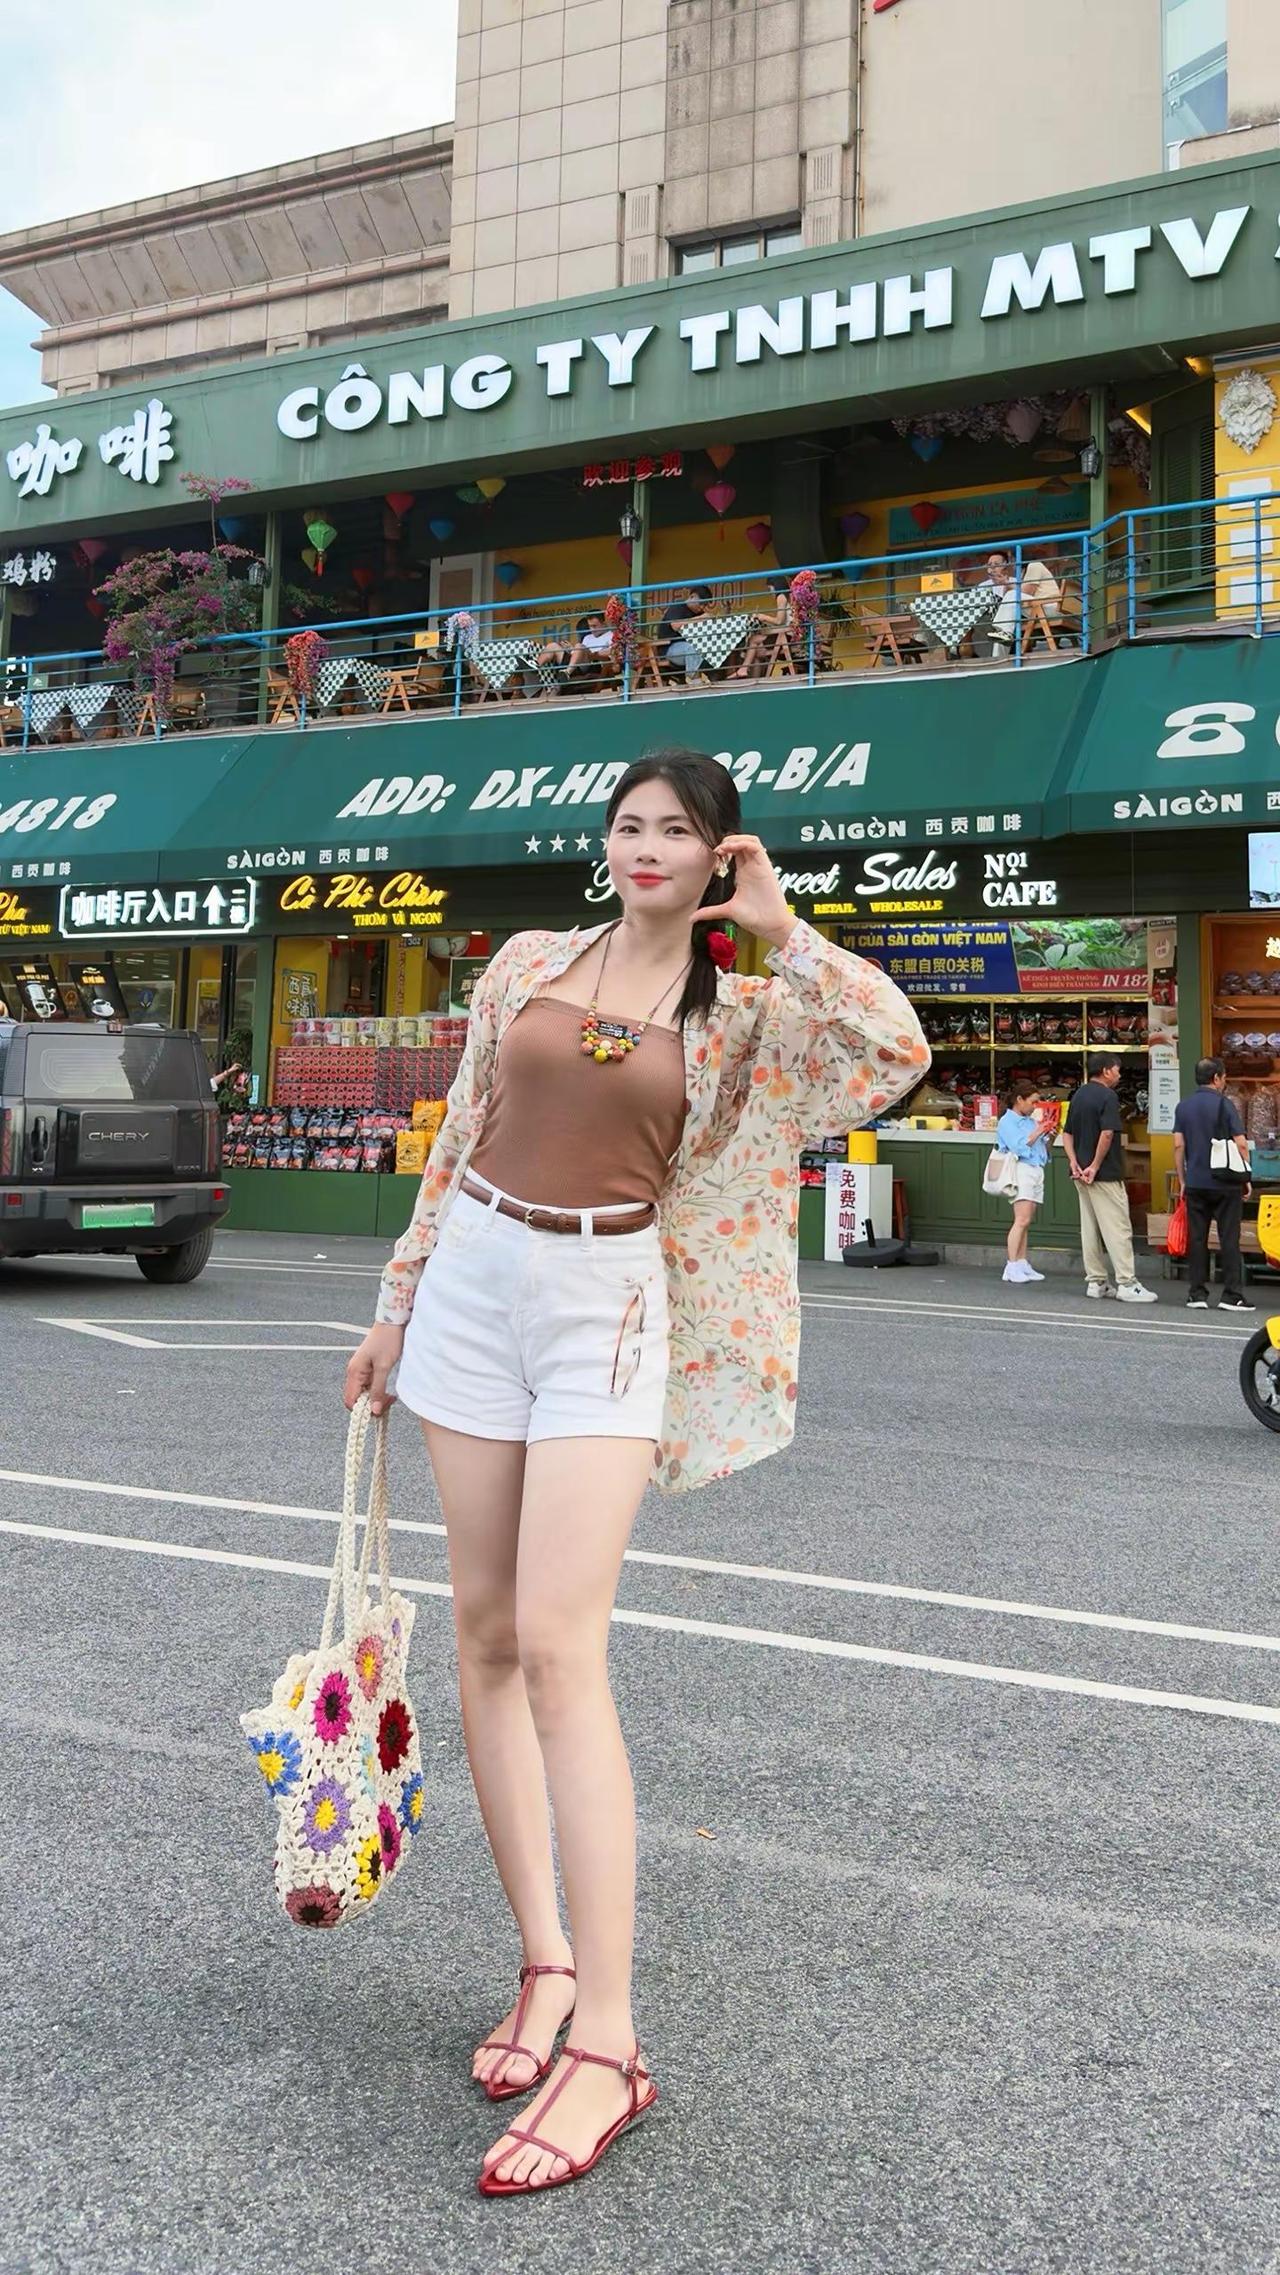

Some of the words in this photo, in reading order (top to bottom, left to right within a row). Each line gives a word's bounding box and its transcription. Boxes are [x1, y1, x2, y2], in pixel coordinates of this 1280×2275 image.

[277, 362, 513, 441] CÔNG
[536, 325, 659, 398] TY
[679, 266, 956, 373] TNHH
[979, 205, 1253, 321] MTV
[336, 773, 457, 819] ADD:
[1113, 789, 1243, 819] SÀIGÒN
[0, 793, 118, 834] 4818
[800, 816, 907, 842] SÀIGÒN
[925, 813, 1023, 836] 西贡咖啡
[319, 846, 389, 865] 西贡咖啡
[773, 863, 841, 895] irect
[854, 850, 958, 896] Sales
[323, 874, 375, 909] Phê
[983, 880, 1058, 908] CAFE
[71, 889, 197, 927] 咖啡厅入口
[392, 910, 406, 927] VÀ
[409, 912, 443, 926] NGON
[870, 900, 944, 913] WHOLESALE
[887, 931, 909, 946] SÀI
[911, 931, 940, 946] GÒN
[943, 930, 973, 948] VIỆT
[975, 932, 1007, 946] NAM
[889, 957, 985, 974] 东盟自贸0关税
[1102, 974, 1119, 987] IN
[88, 1132, 149, 1141] CHERY
[838, 1168, 856, 1249] 免费咖啡
